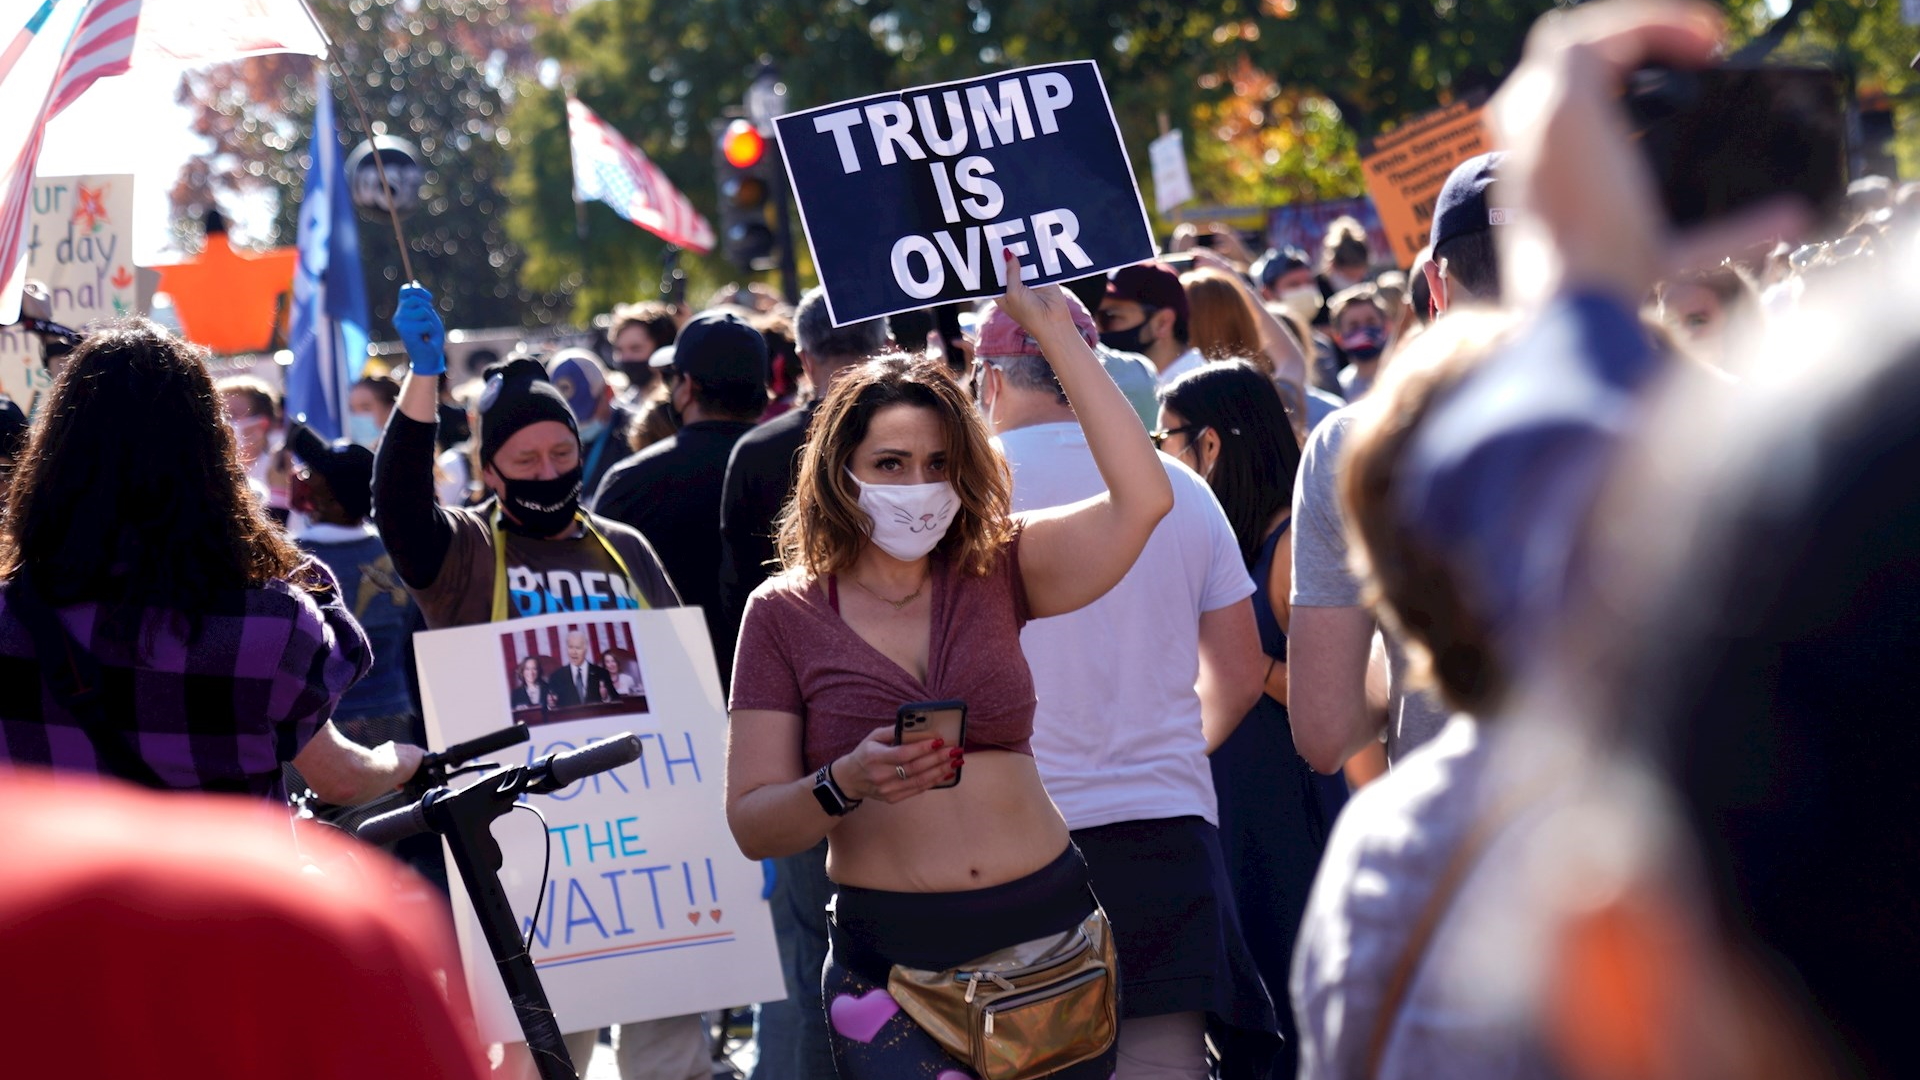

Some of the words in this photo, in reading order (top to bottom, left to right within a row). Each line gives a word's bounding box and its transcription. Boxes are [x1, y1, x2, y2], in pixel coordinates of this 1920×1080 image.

[813, 72, 1074, 174] TRUMP
[930, 156, 1004, 224] IS
[56, 219, 118, 280] day
[890, 208, 1094, 299] OVER
[507, 565, 639, 617] BIDEN
[548, 816, 648, 867] THE
